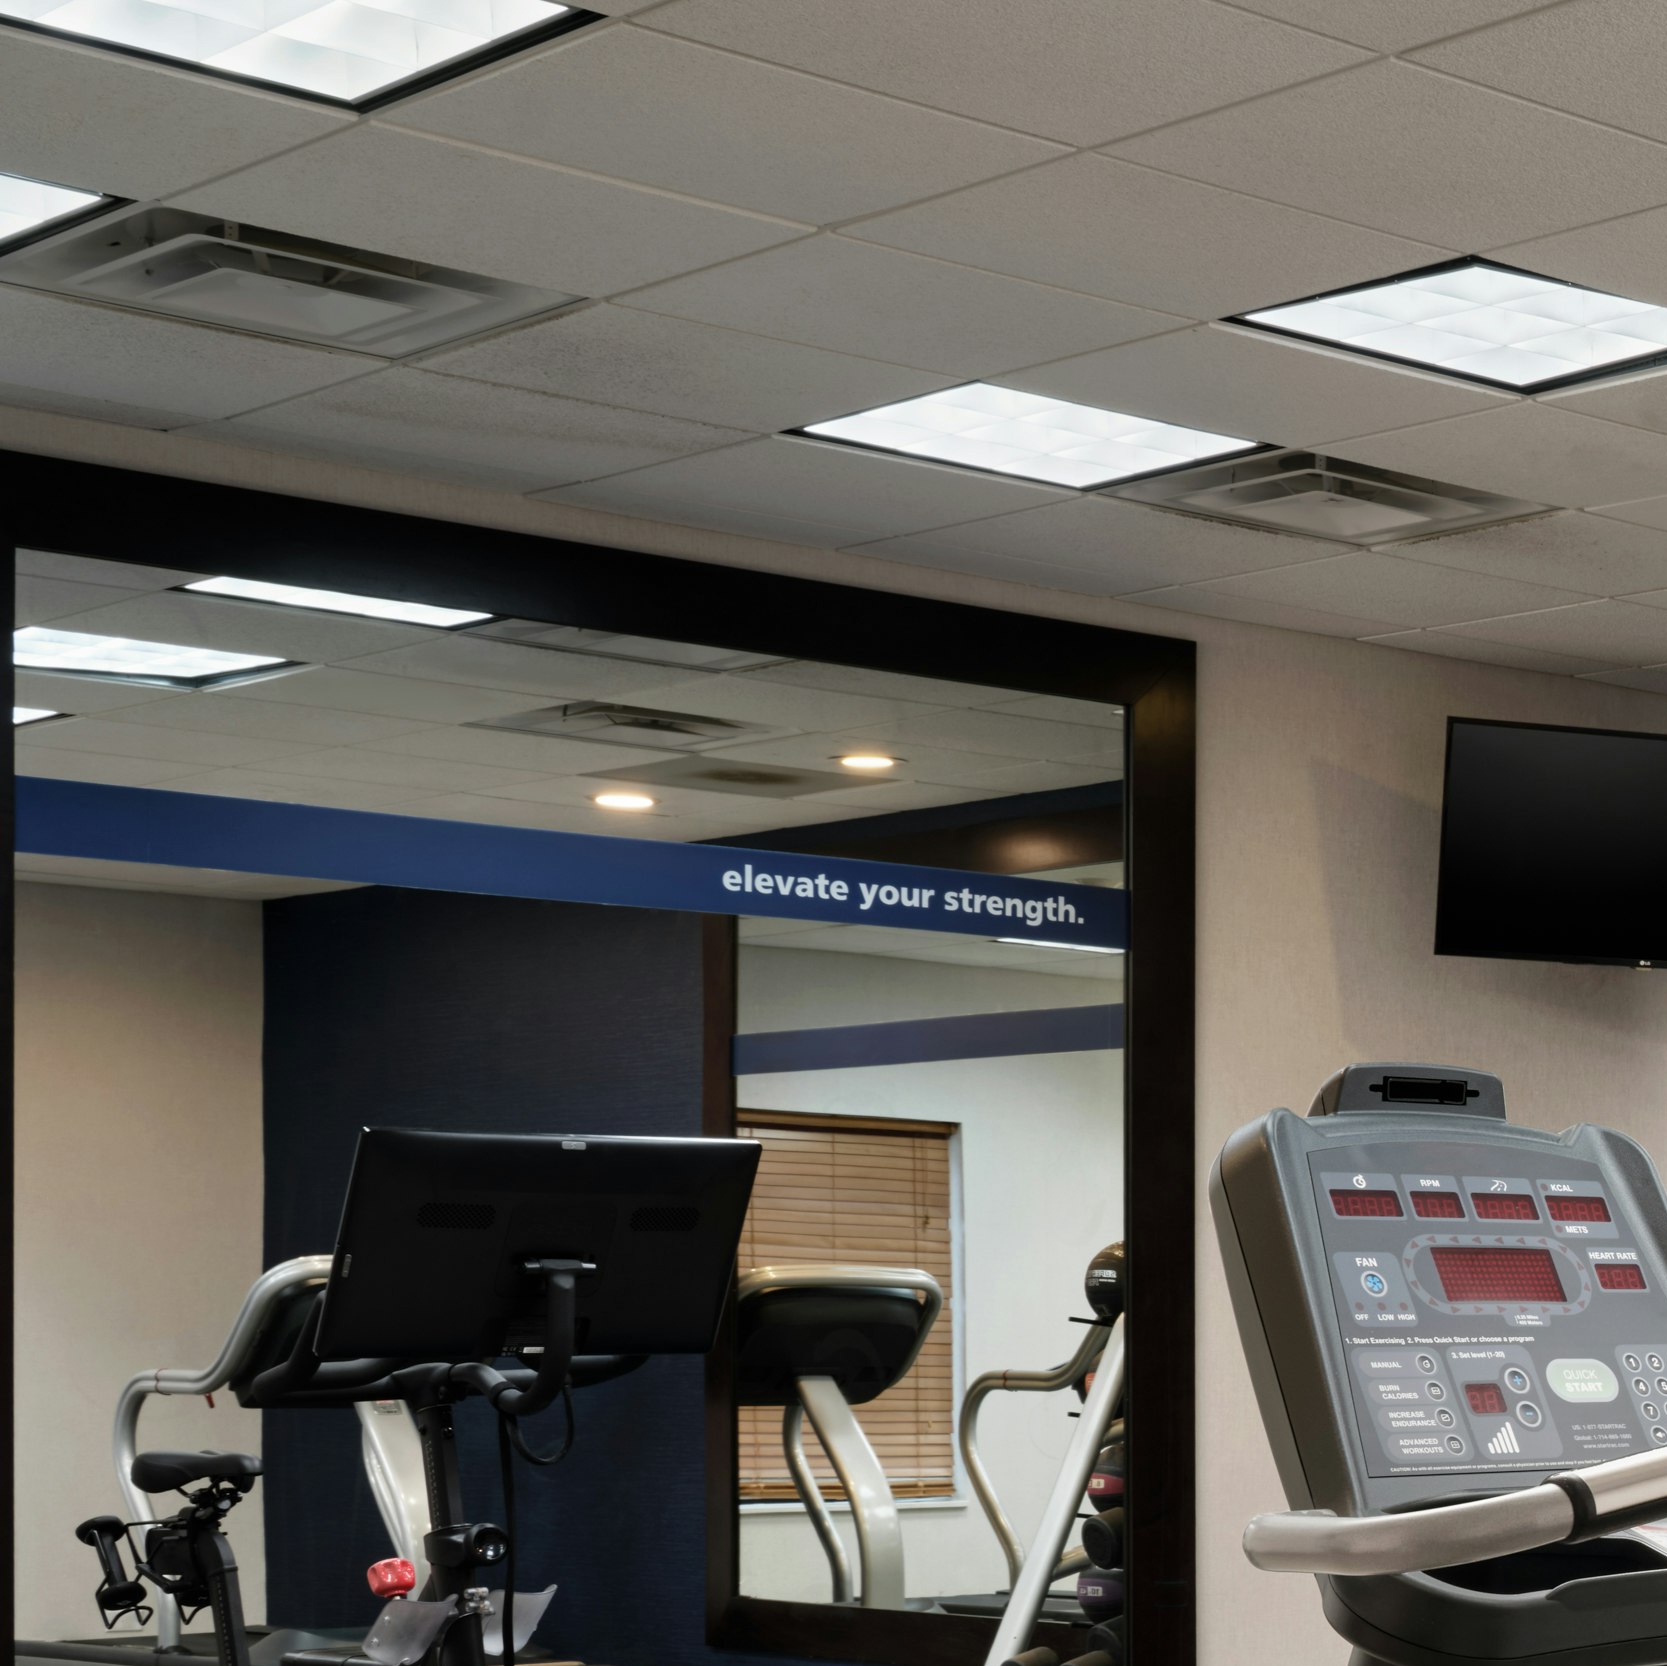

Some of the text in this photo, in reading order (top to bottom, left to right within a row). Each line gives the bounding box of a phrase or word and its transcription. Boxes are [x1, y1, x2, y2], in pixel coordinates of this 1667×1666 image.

[722, 865, 1085, 926] elevate your strength.
[1420, 1179, 1441, 1187] RPM
[1550, 1184, 1573, 1192] KCAL
[1566, 1226, 1589, 1234] METS
[1589, 1252, 1638, 1260] HEART RATE
[1355, 1258, 1378, 1267] FAN
[1487, 1351, 1506, 1359] (1-20)
[1629, 1358, 1636, 1368] 1
[1652, 1358, 1660, 1368] 2
[1563, 1370, 1597, 1380] QUICK
[1565, 1383, 1604, 1393] START
[1639, 1382, 1646, 1391] 4
[1648, 1406, 1654, 1416] 7
